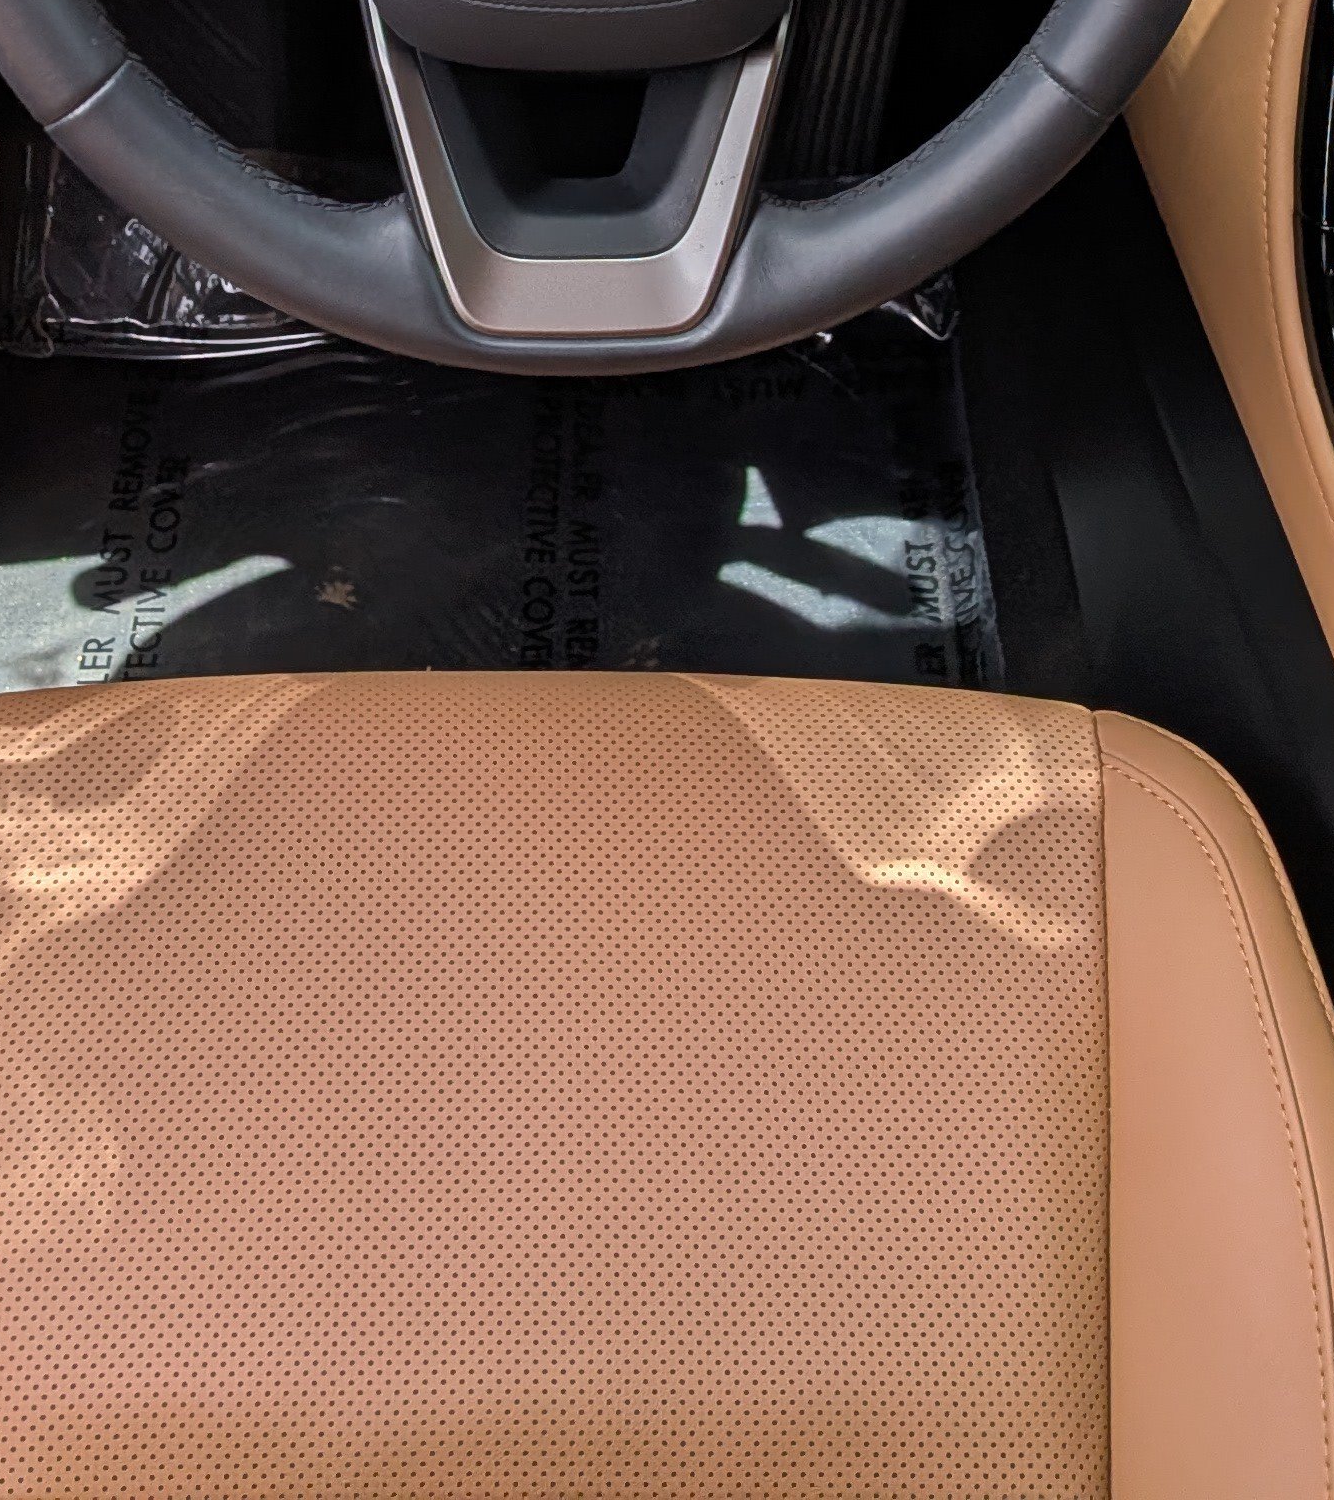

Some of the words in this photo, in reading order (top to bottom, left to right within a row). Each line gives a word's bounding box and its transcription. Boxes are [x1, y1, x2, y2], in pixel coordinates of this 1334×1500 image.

[94, 528, 135, 615] MUST
[568, 519, 600, 601] MUST
[904, 540, 942, 623] MUST
